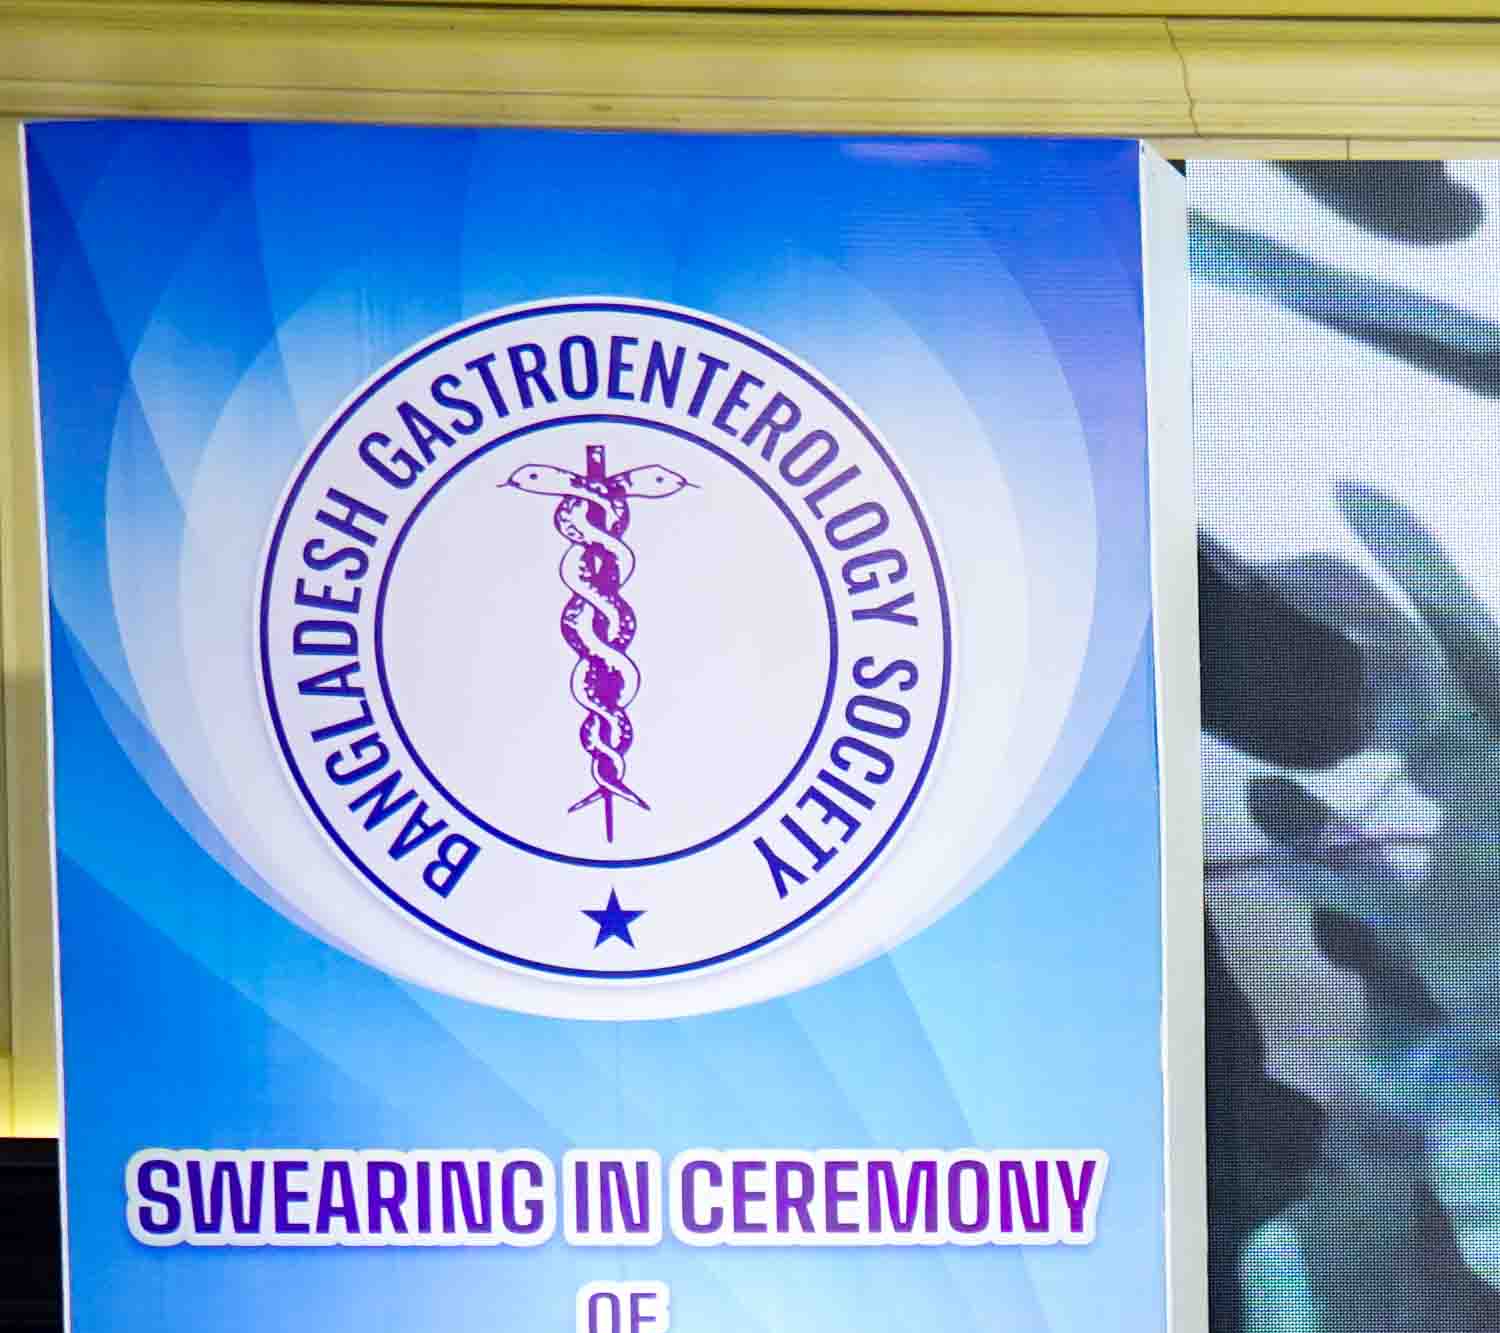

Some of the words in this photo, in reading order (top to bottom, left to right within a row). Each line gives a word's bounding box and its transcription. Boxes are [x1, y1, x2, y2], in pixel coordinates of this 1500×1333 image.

[356, 332, 920, 629] GASTROENTEROLOGY
[291, 486, 482, 902] BANGLADESH
[763, 655, 919, 902] SOCIETY
[136, 1157, 545, 1236] SWEARING
[574, 1158, 650, 1235] IN
[679, 1157, 1099, 1235] CEREMONY
